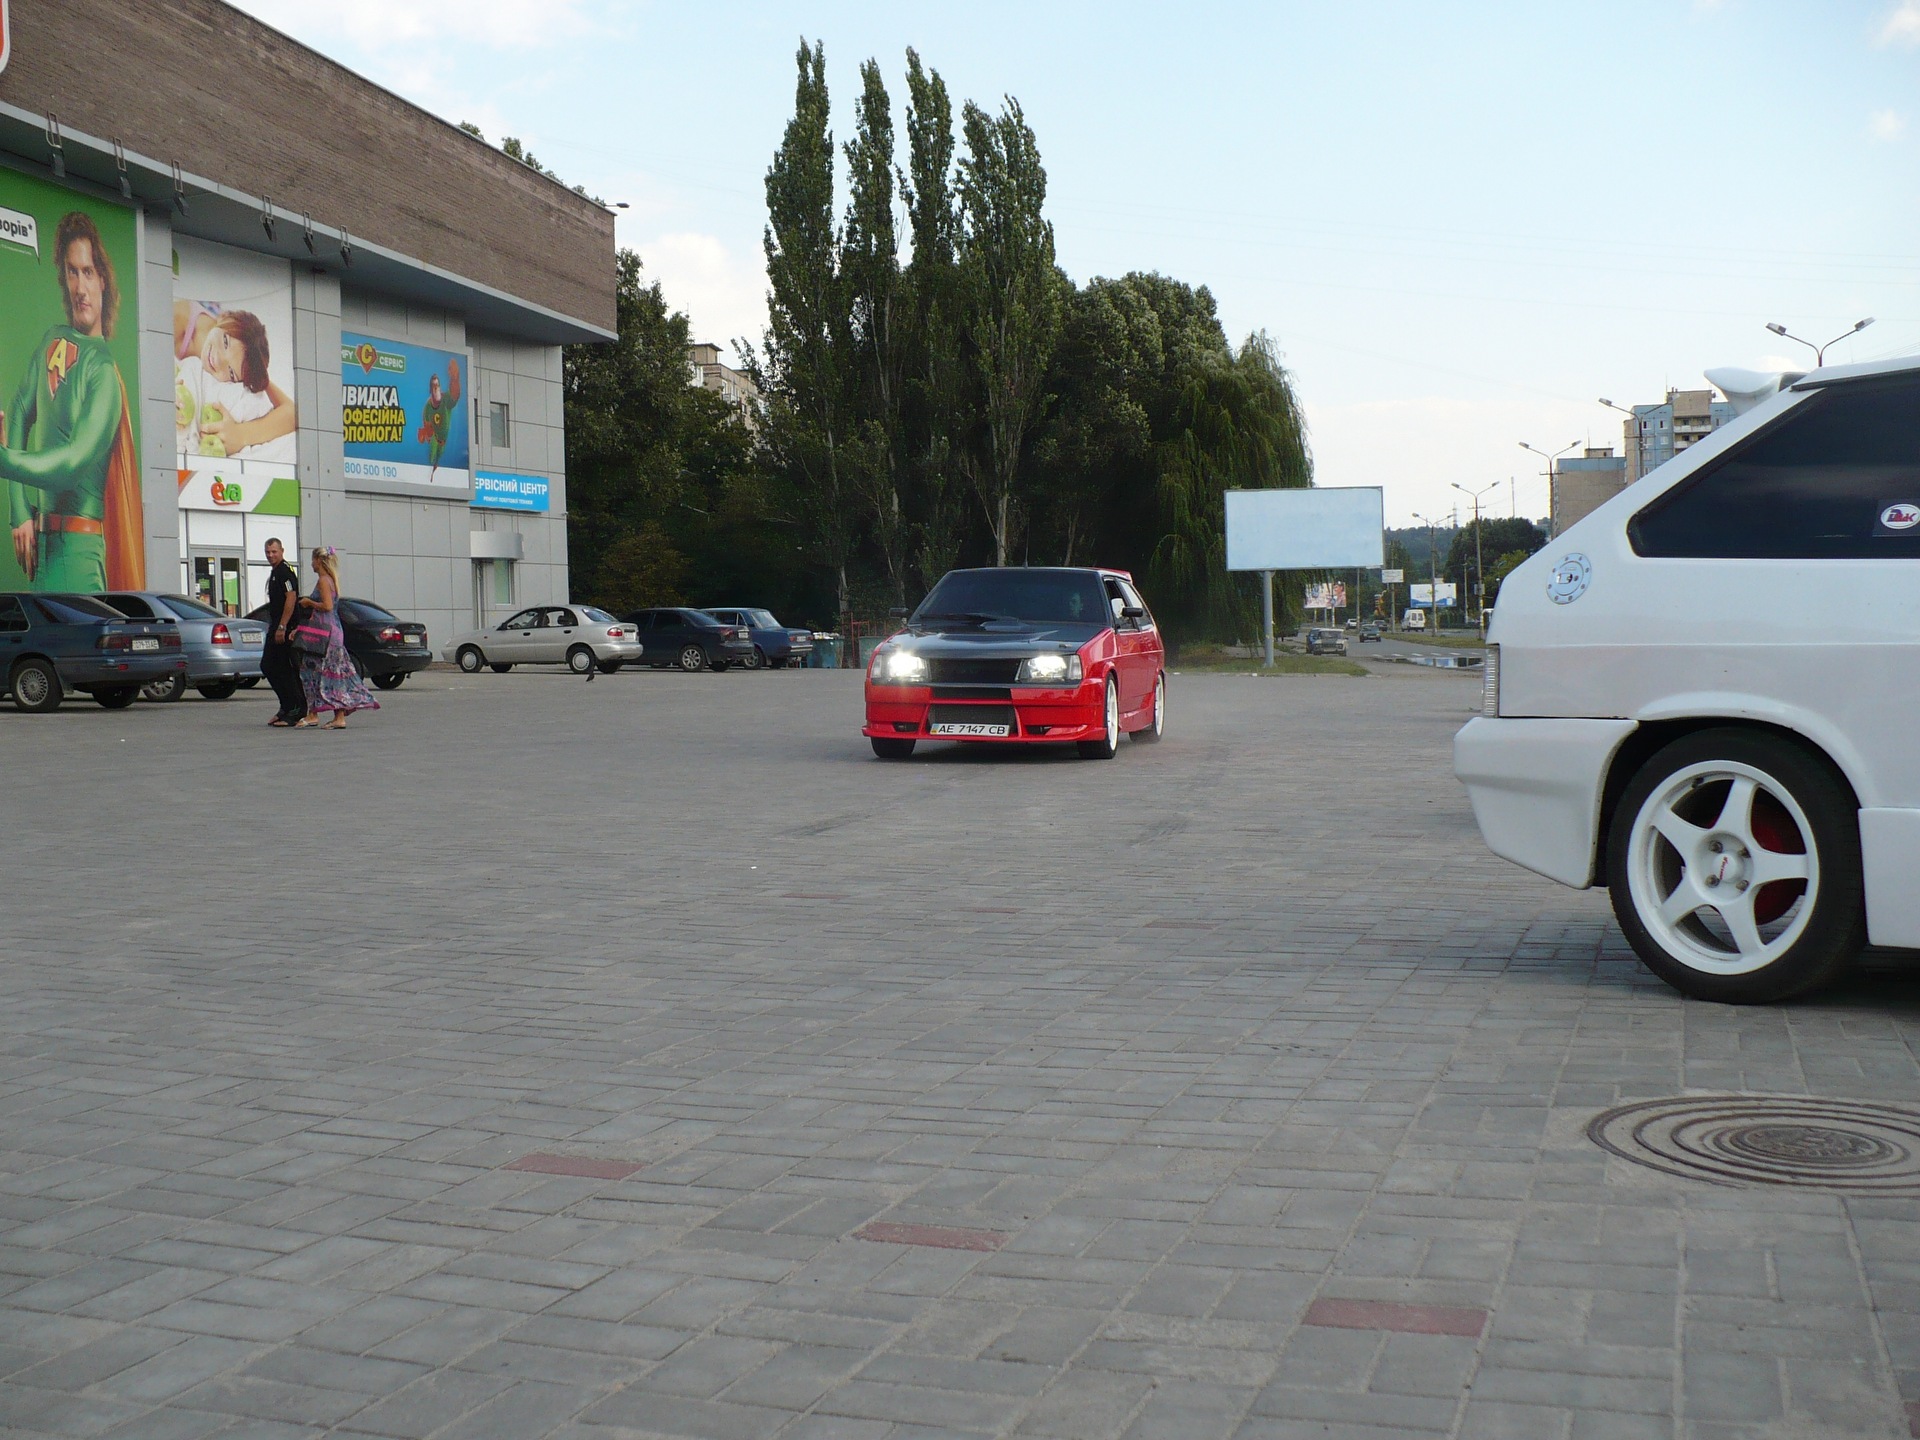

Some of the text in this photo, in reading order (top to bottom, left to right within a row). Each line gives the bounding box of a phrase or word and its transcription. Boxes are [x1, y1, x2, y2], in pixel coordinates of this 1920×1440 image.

[379, 356, 404, 369] СЕРВІС
[344, 462, 397, 478] 800 500 190
[520, 482, 548, 496] ЦЕНТР
[939, 724, 1006, 735] AE 7147 CB
